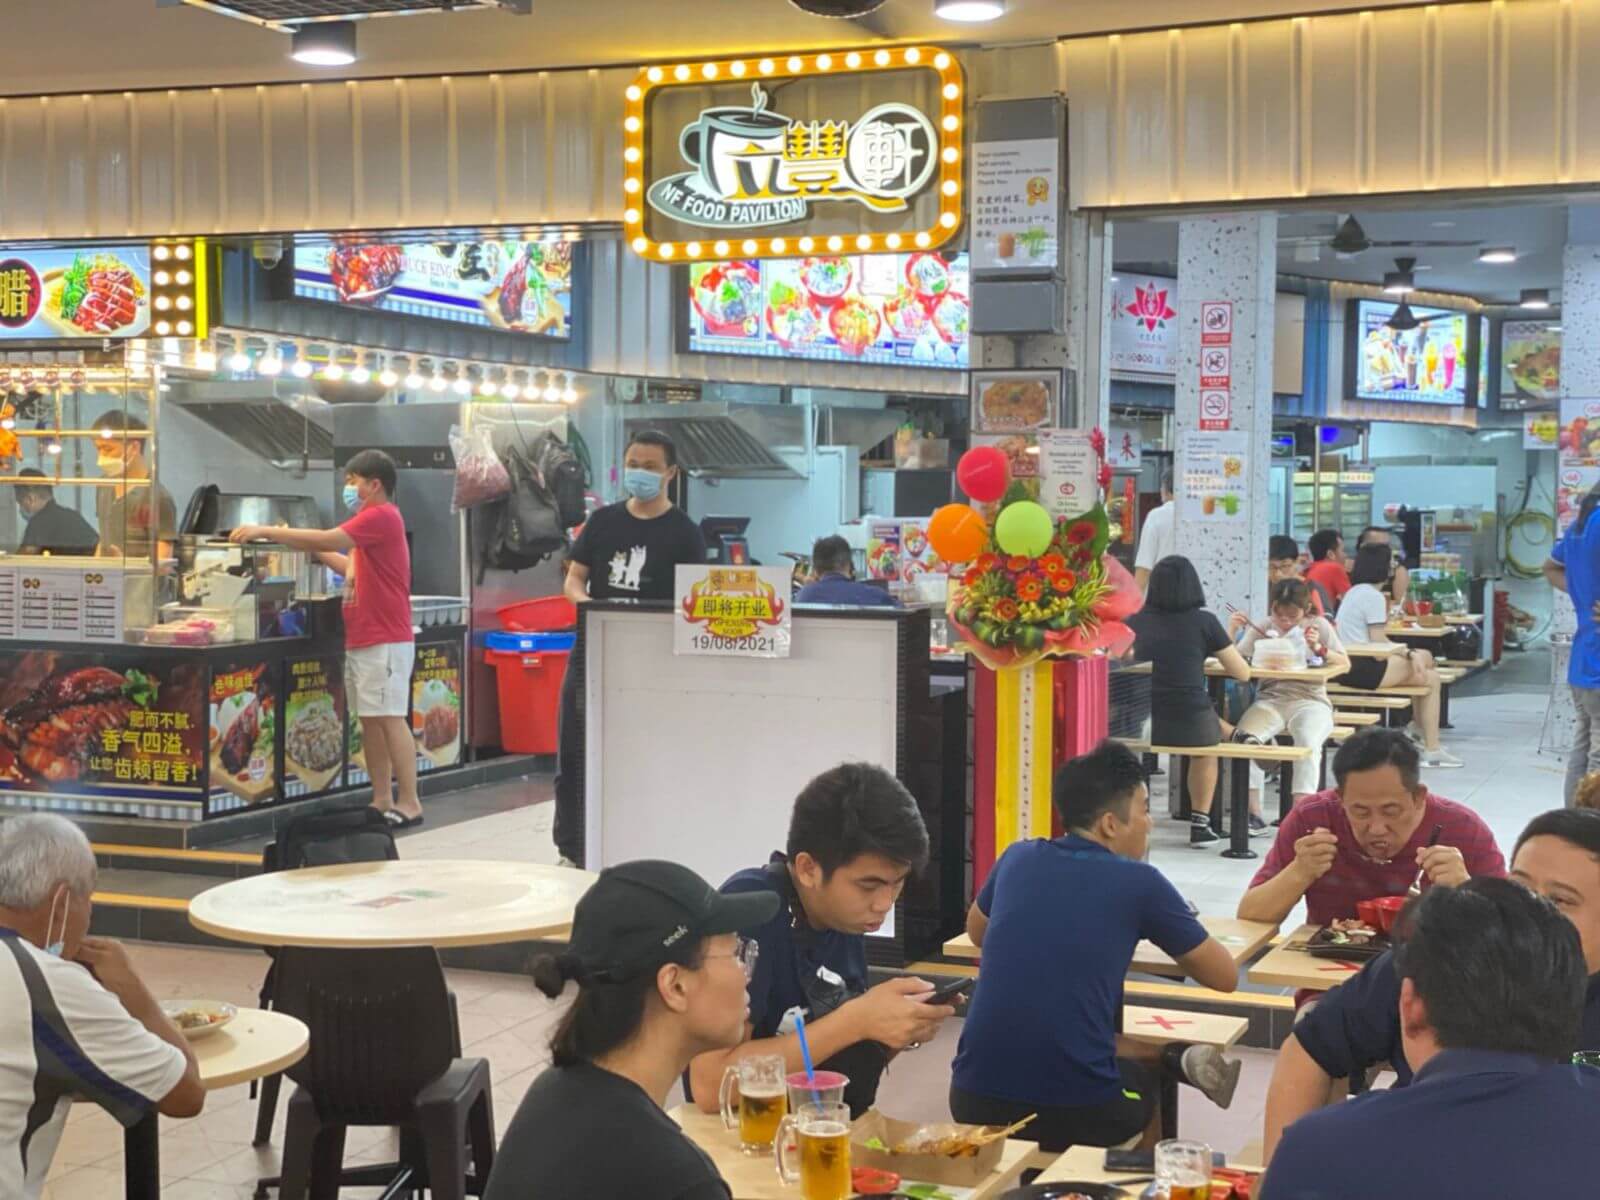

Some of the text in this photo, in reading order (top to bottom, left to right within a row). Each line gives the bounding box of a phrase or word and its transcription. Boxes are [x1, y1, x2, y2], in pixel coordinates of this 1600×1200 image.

[661, 183, 683, 206] NF
[682, 195, 726, 221] FOOD
[703, 599, 766, 616] 即将开业
[692, 635, 776, 651] 19/08/2021
